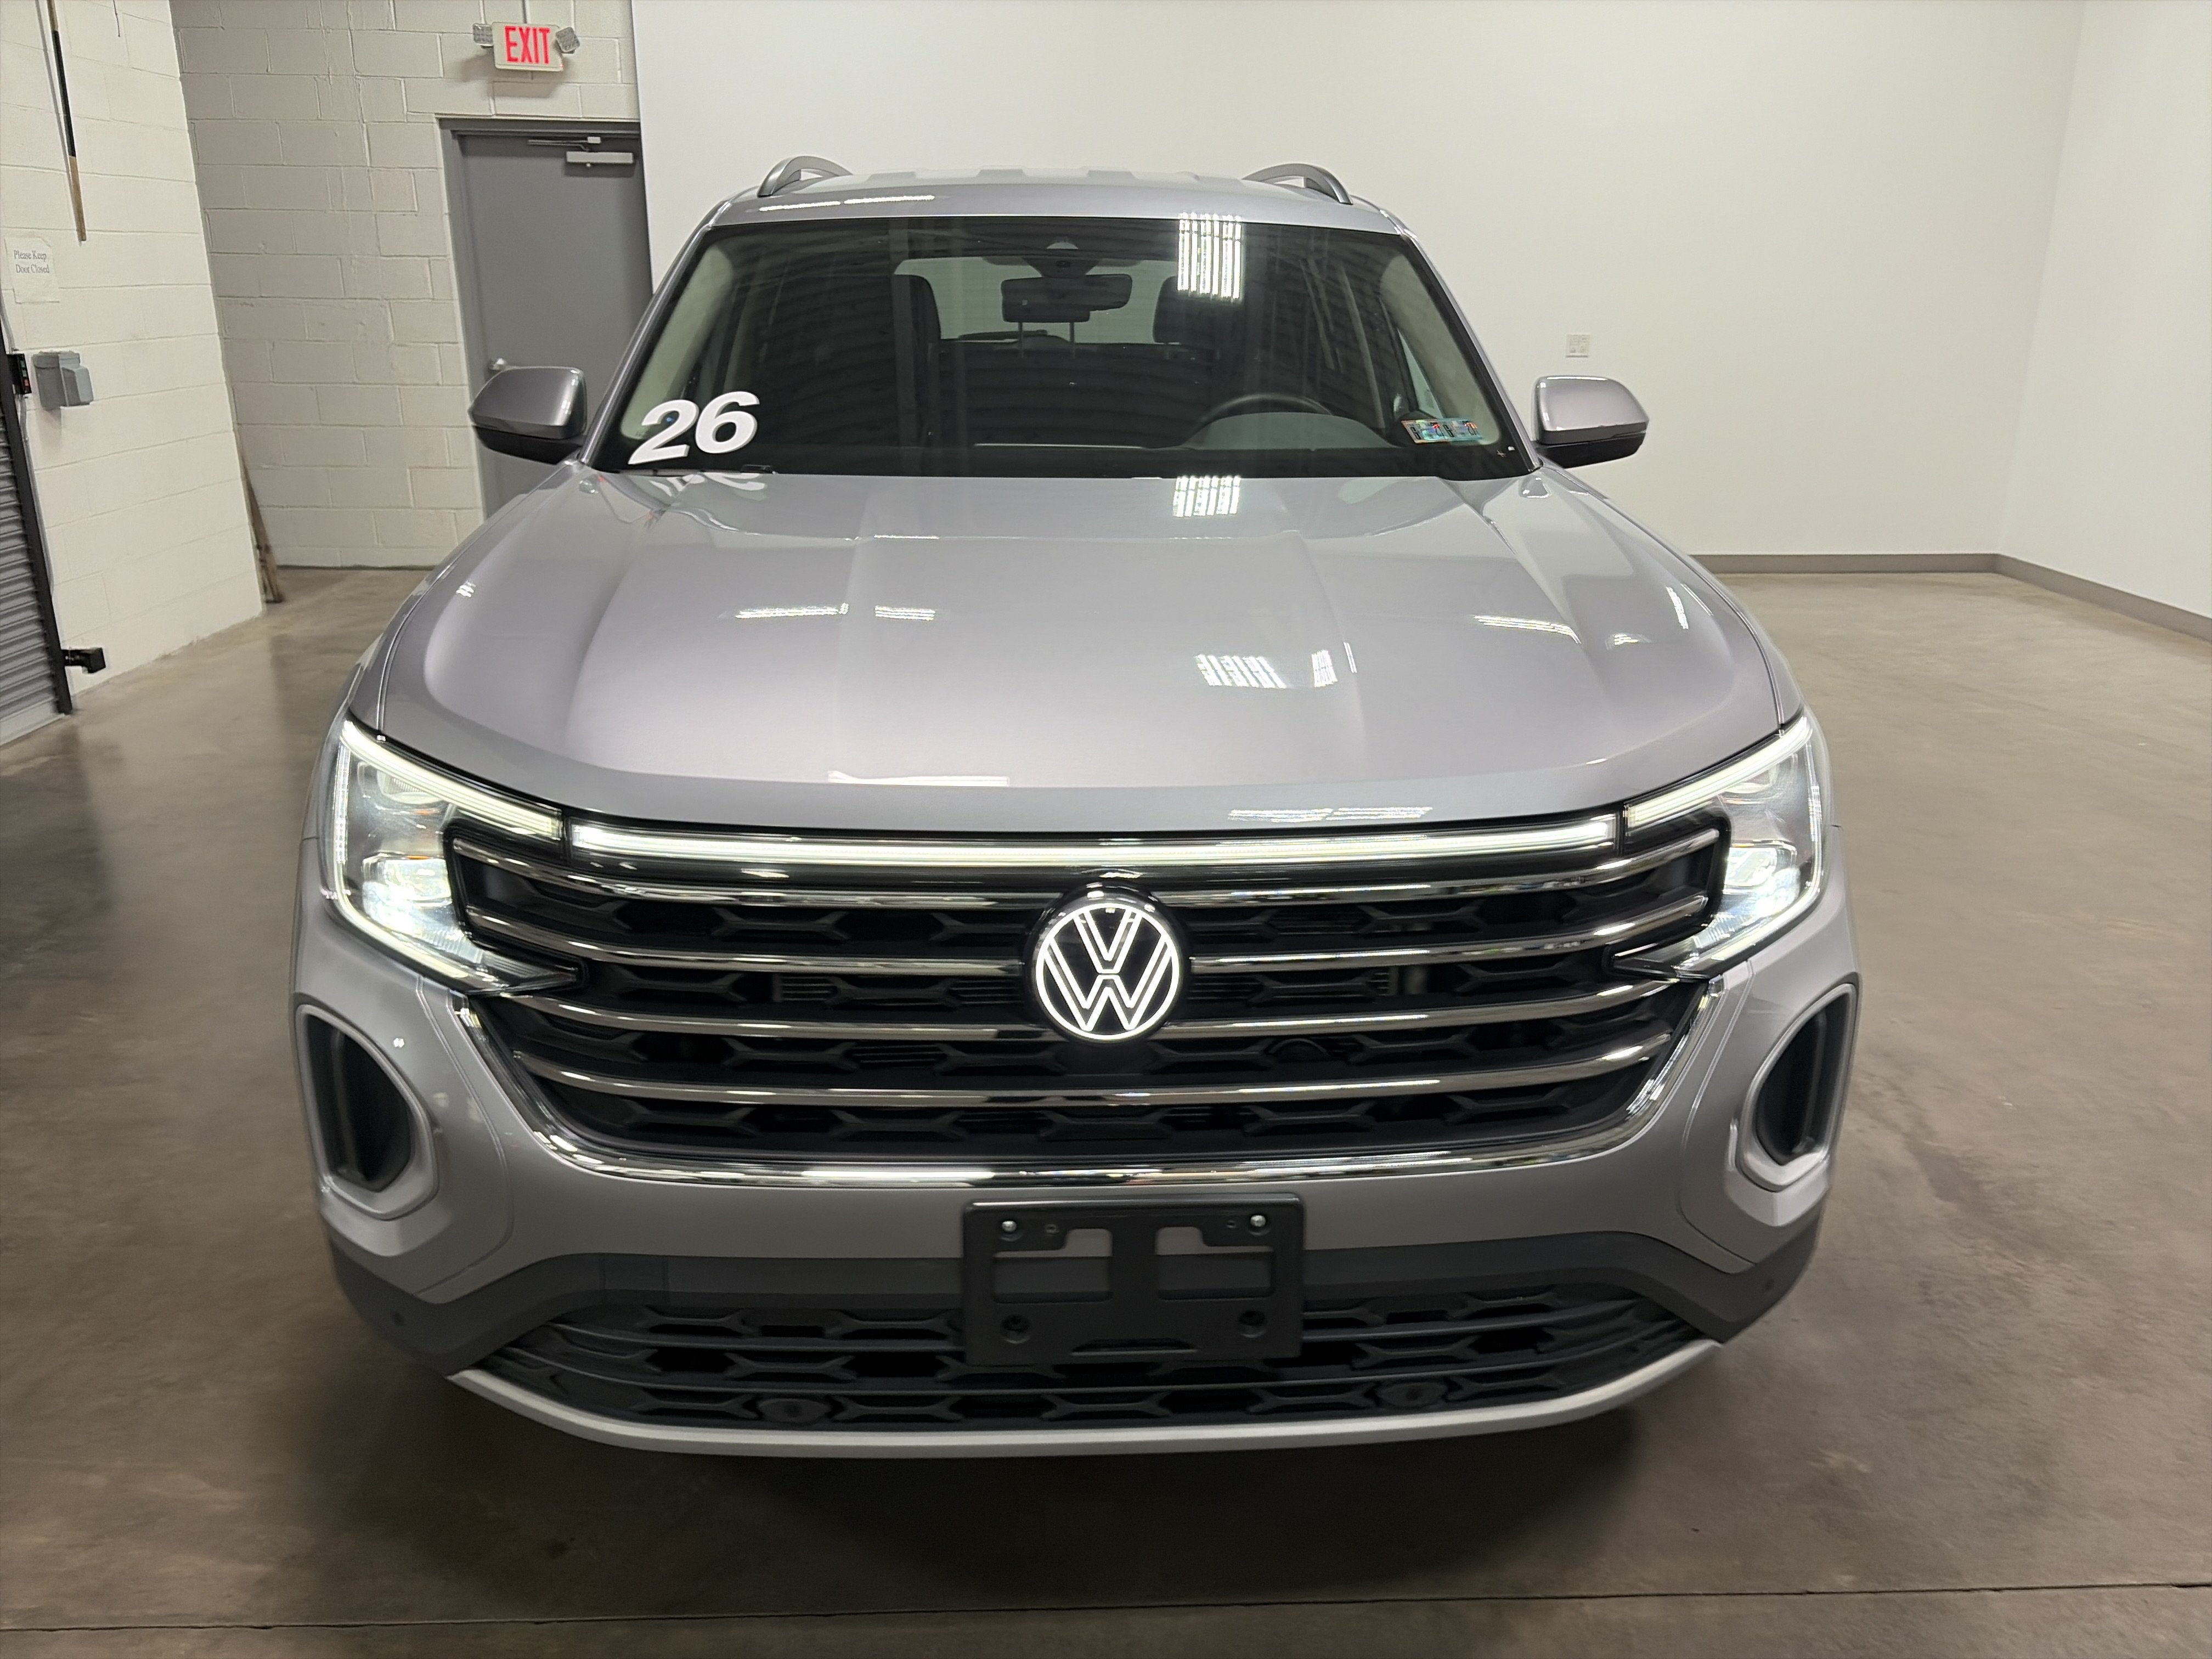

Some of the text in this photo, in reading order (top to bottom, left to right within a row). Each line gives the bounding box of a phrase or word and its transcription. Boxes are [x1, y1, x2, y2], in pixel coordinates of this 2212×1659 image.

[504, 25, 550, 64] EXIT
[13, 250, 47, 262] Please Keep
[15, 264, 49, 273] Door Closed
[628, 391, 760, 465] 26
[1039, 904, 1176, 1036] VW
